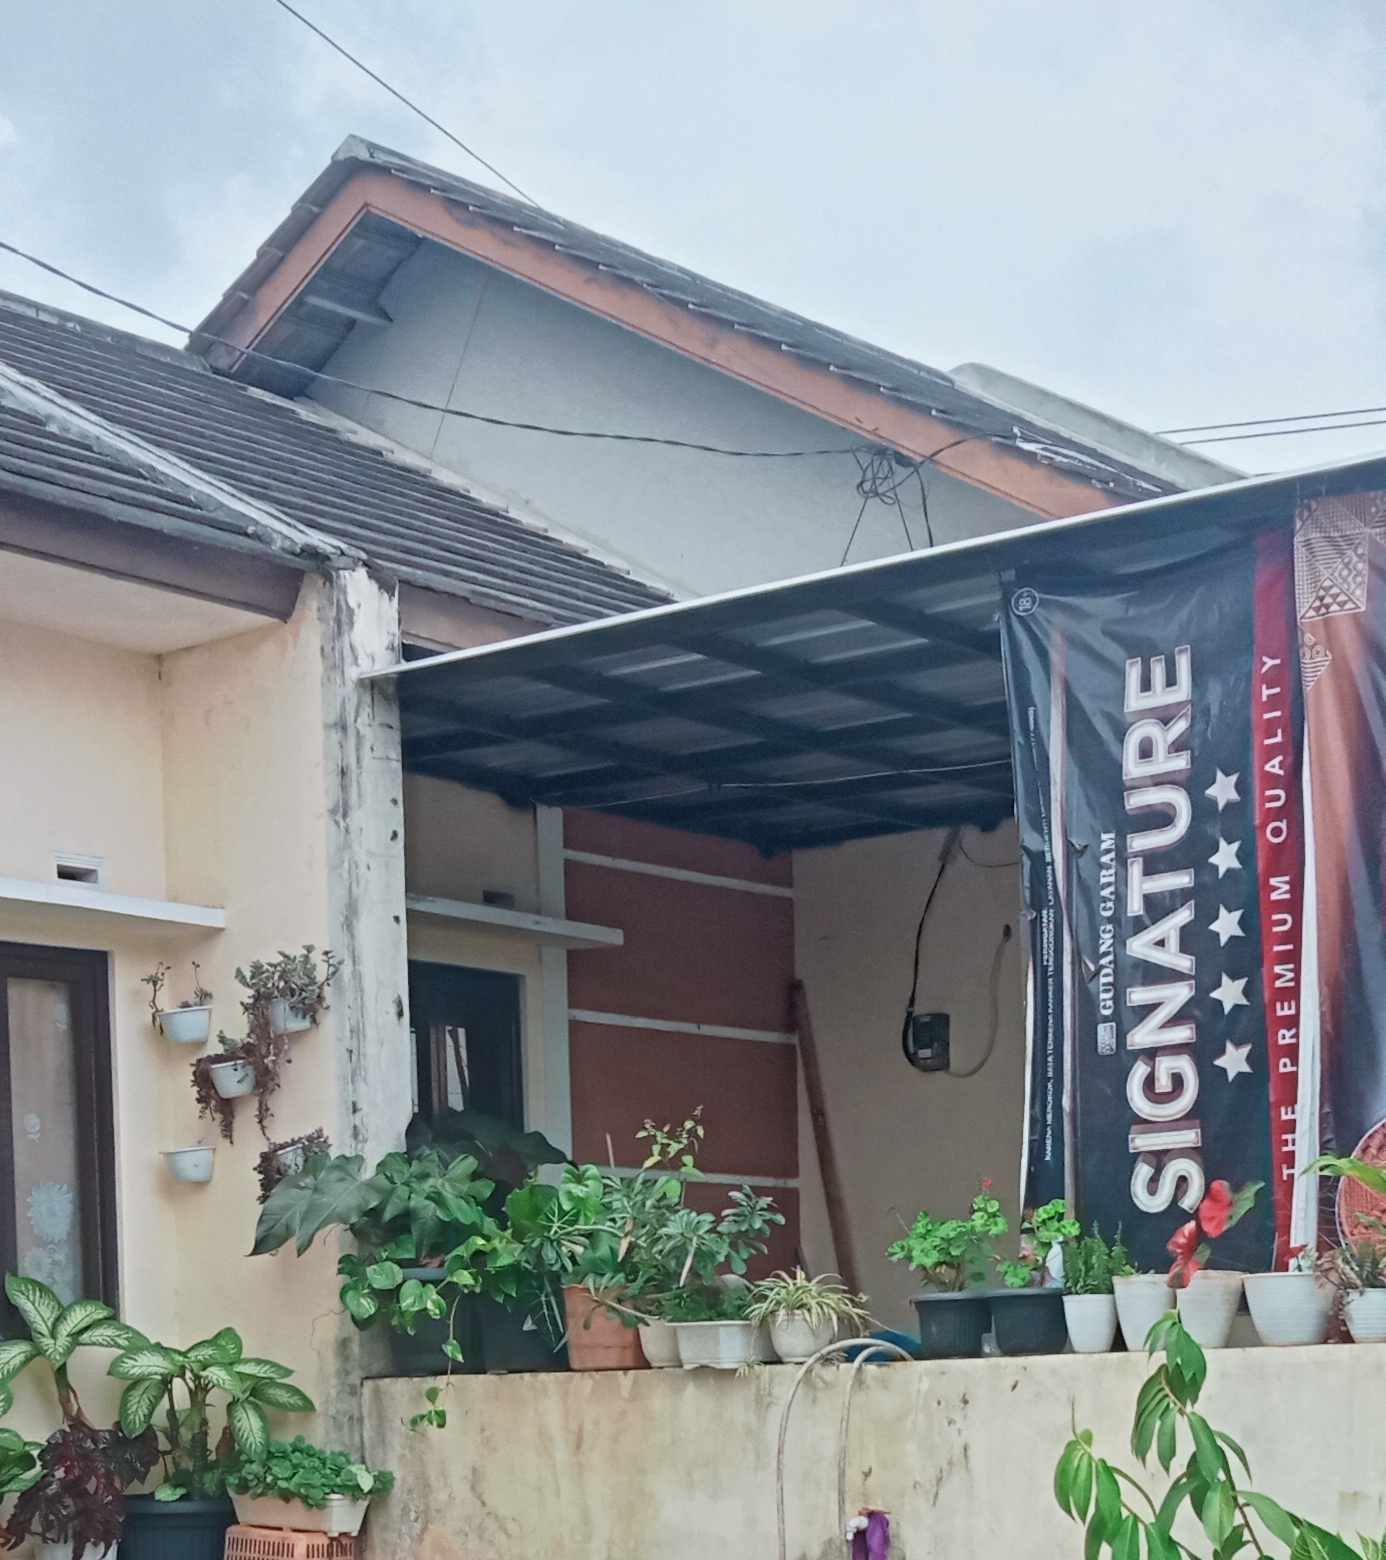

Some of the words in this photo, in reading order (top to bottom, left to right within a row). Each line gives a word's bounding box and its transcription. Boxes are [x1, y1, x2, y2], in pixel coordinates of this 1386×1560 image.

[1261, 654, 1288, 844] QUALITY
[1100, 832, 1116, 918] GARAM
[1124, 645, 1205, 1214] SIGNATURE
[1098, 923, 1115, 1016] GUDANG
[1273, 874, 1298, 1073] PREMIUM
[1281, 1103, 1298, 1181] THE
